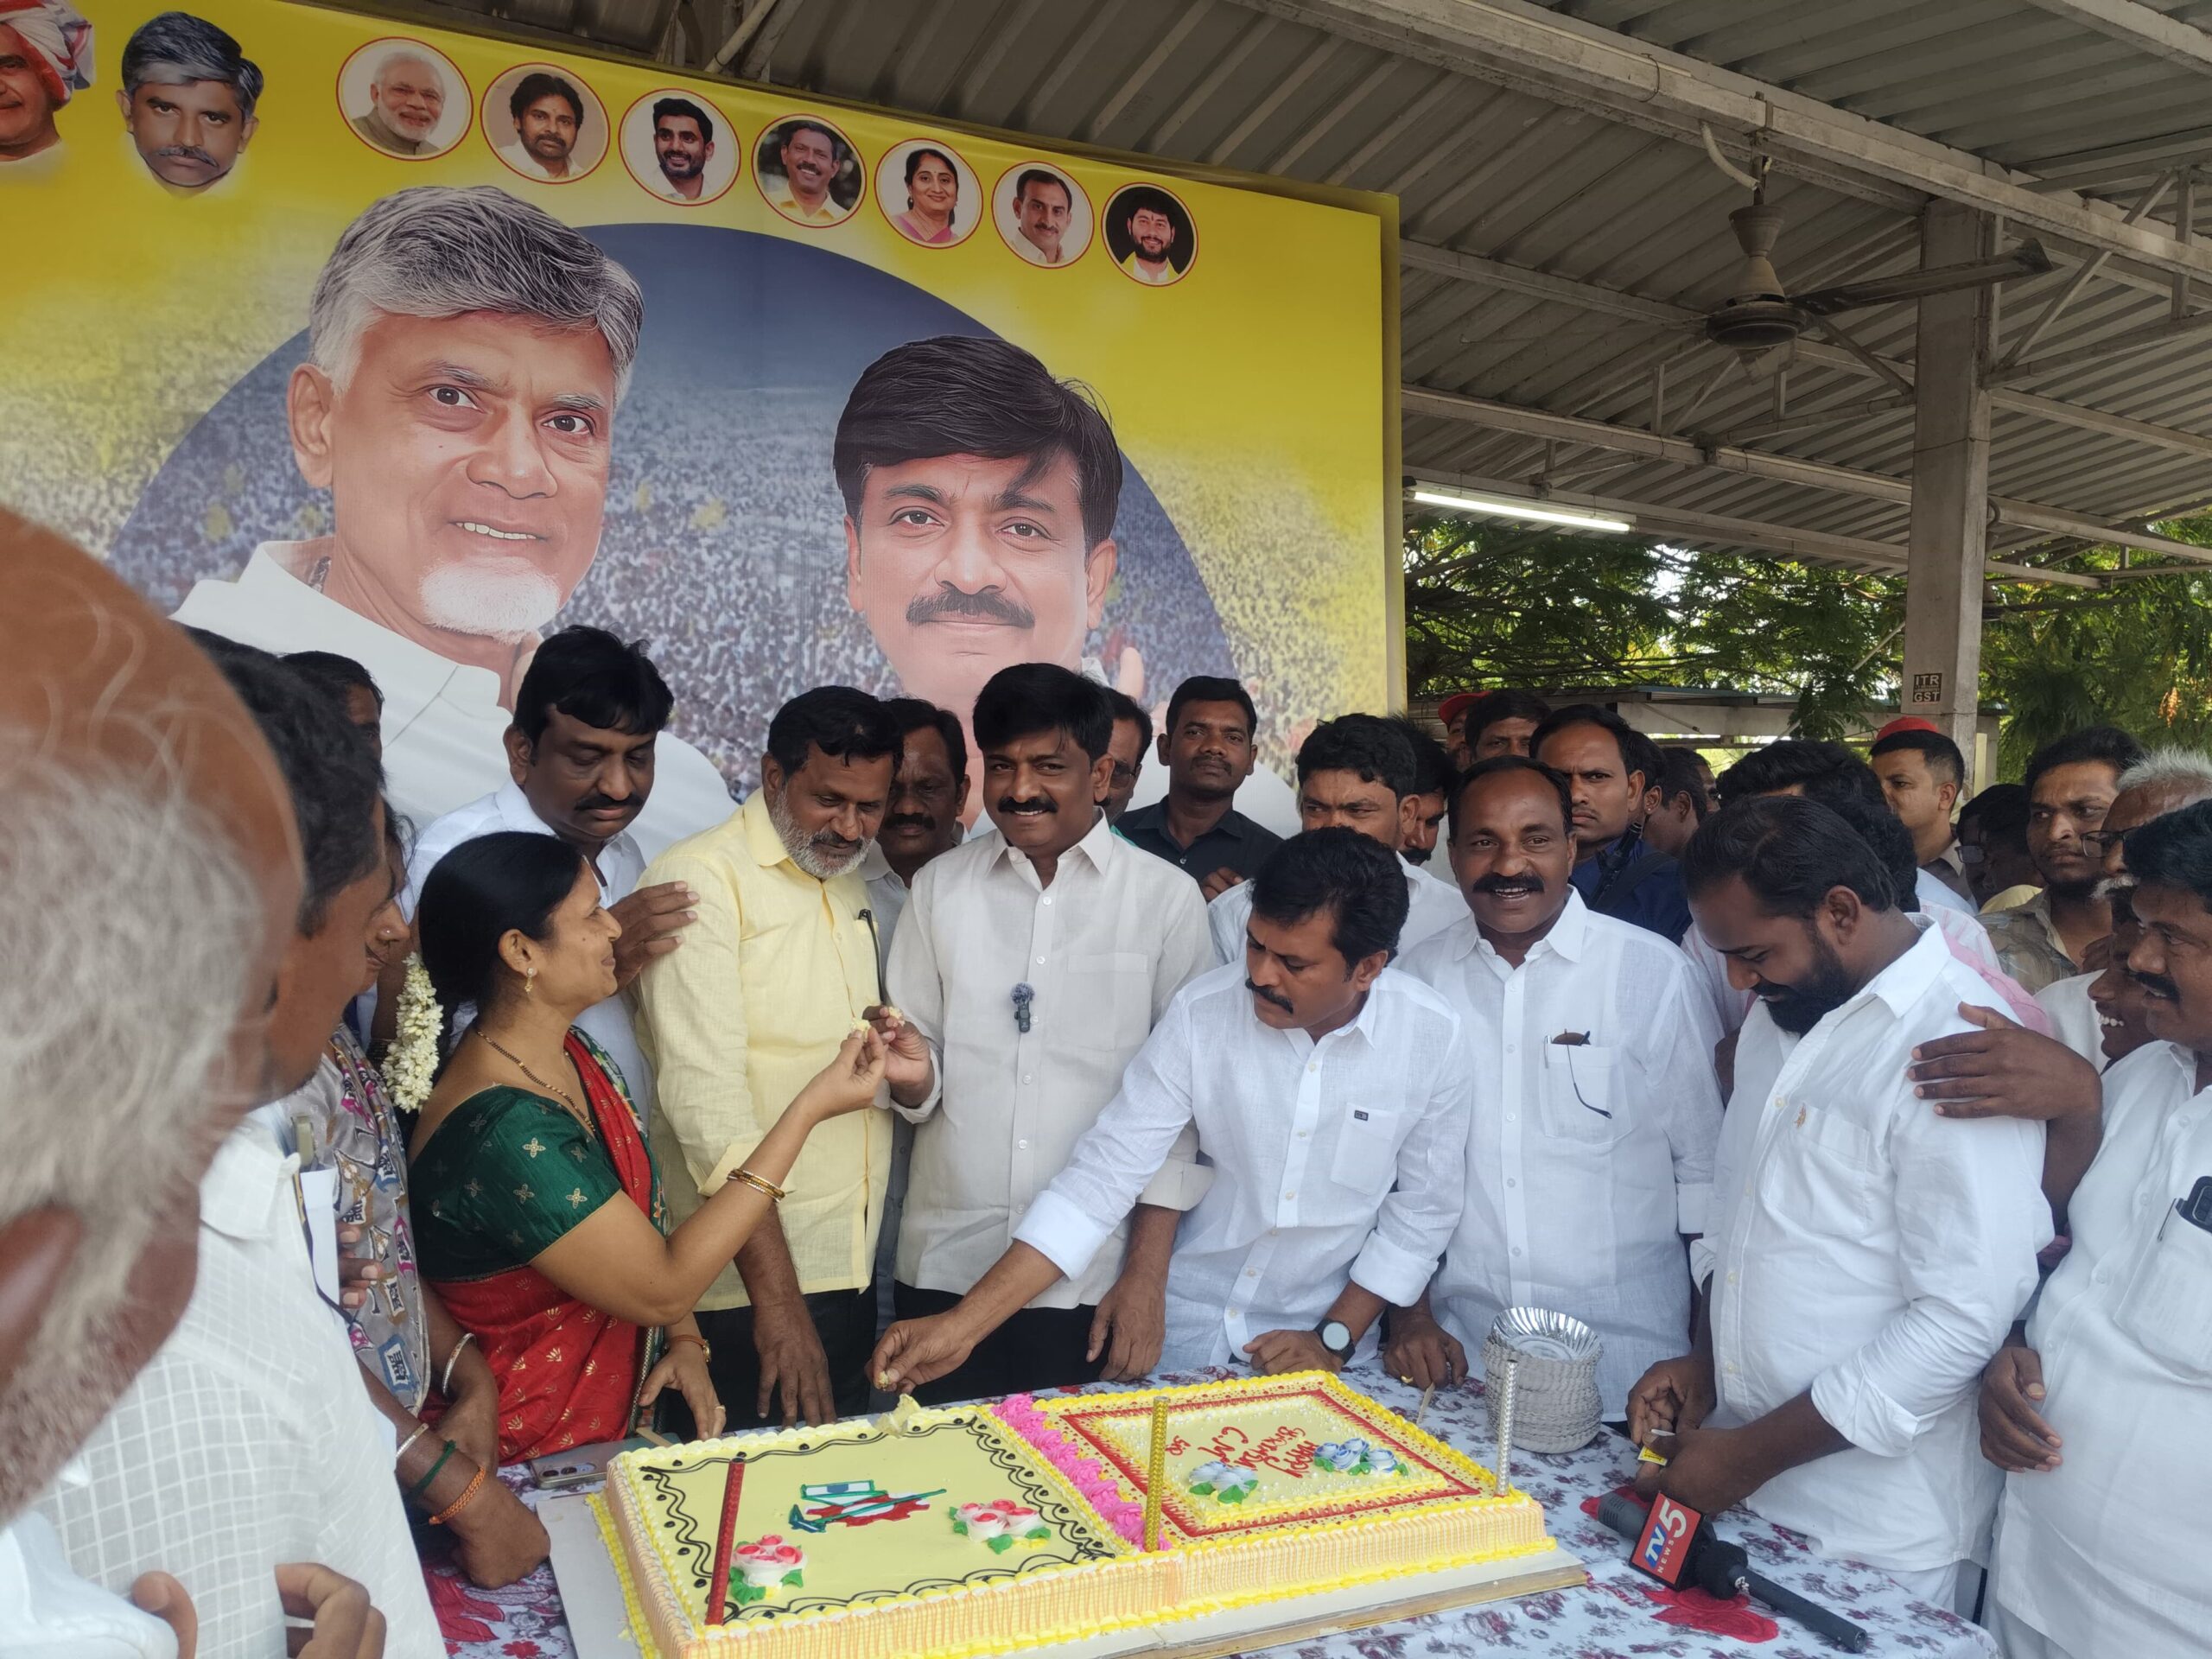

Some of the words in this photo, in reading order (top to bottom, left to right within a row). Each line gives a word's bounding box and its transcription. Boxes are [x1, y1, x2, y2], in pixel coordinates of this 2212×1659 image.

[1916, 675, 1940, 685] ITR
[1914, 691, 1940, 702] GST
[1656, 1539, 1675, 1574] NEWS
